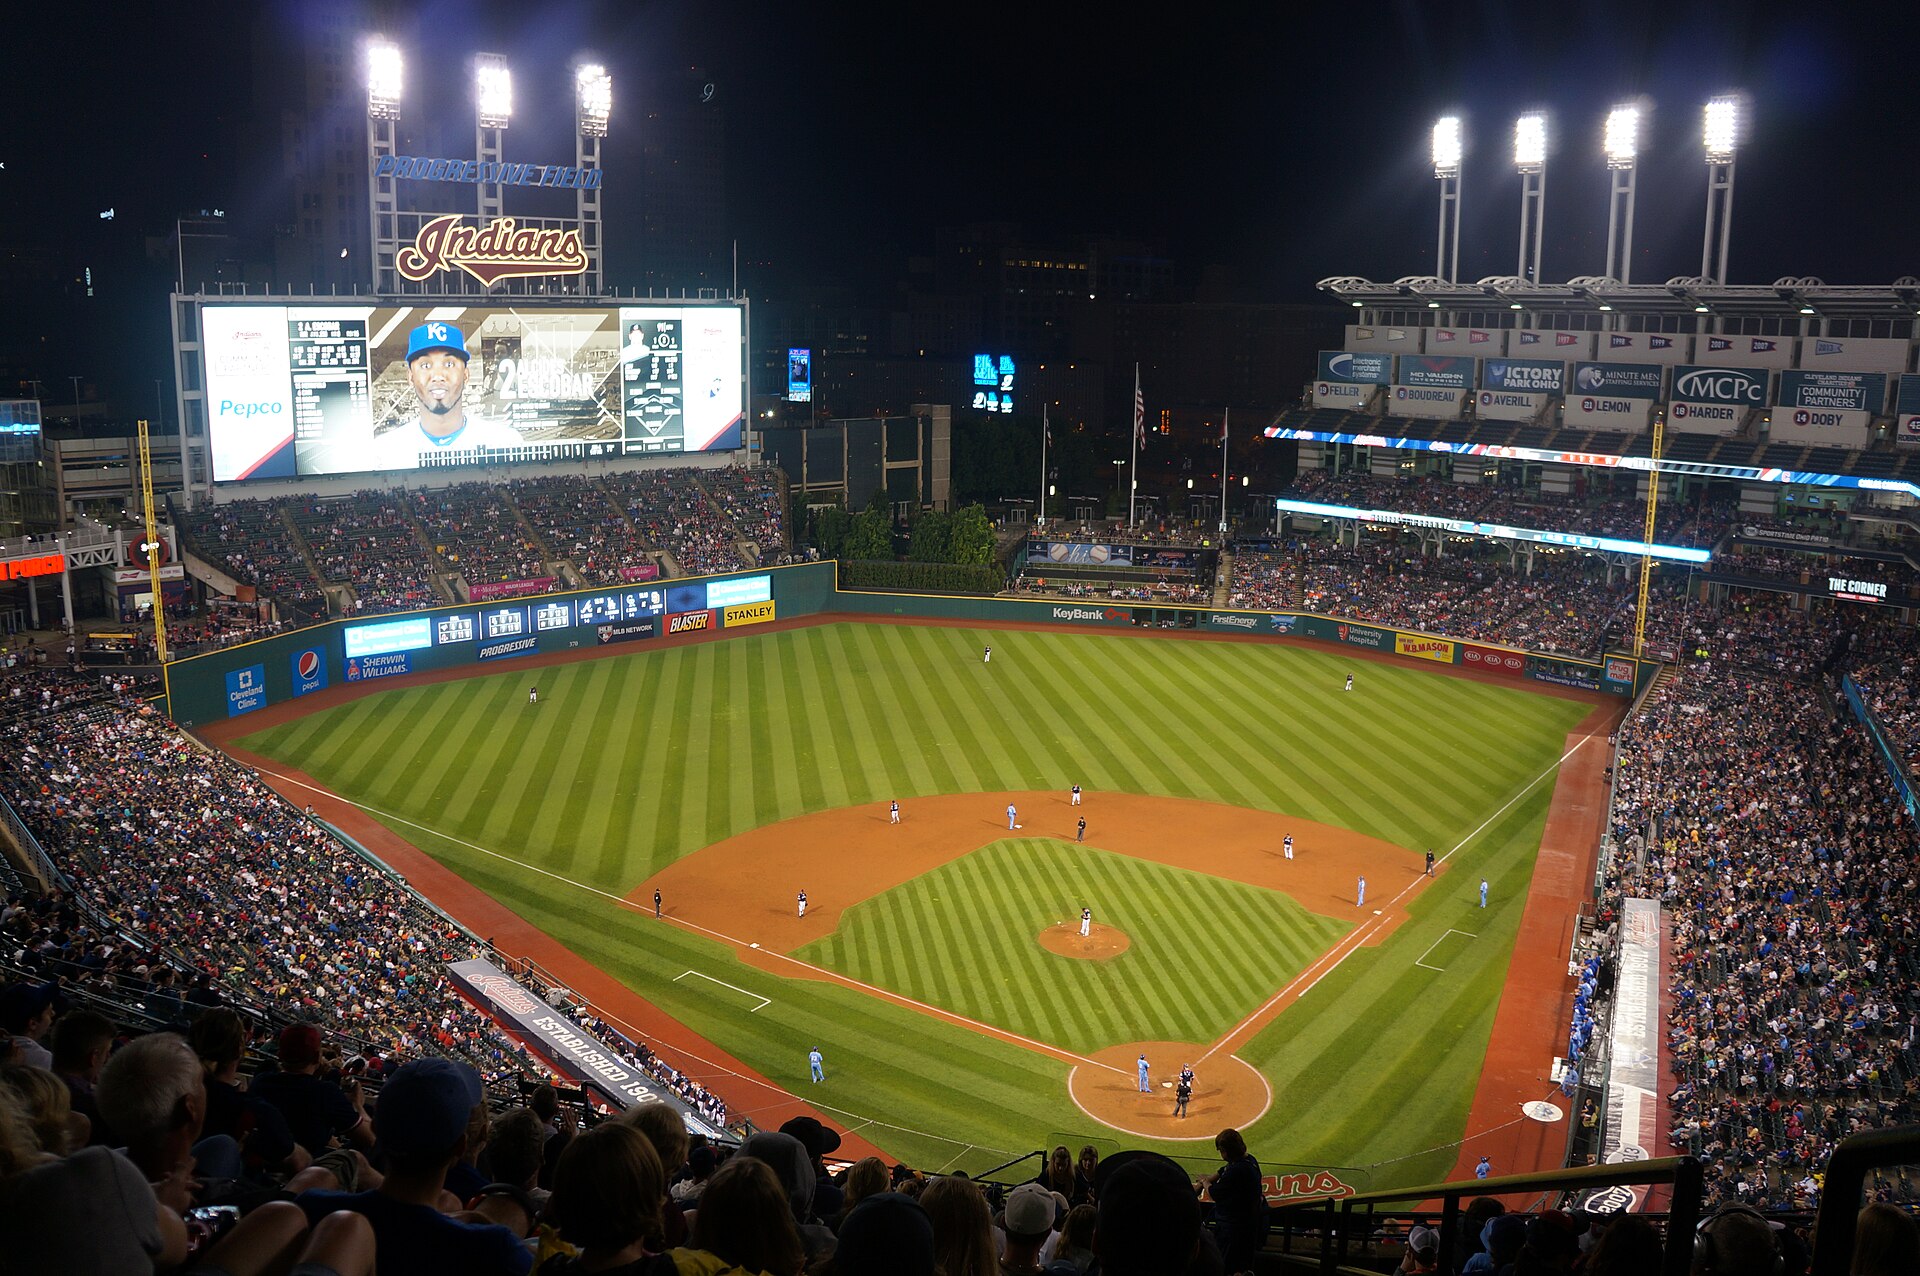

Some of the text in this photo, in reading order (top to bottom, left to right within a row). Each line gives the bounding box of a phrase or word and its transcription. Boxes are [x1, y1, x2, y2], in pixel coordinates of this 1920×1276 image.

[374, 155, 603, 189] PROGRESSIVE FIELD
[396, 213, 589, 287] Indians
[427, 323, 448, 341] KC
[1753, 342, 1769, 350] 2007
[975, 354, 992, 368] Elk
[1352, 358, 1381, 366] electronic
[499, 358, 516, 399] 2
[1426, 372, 1463, 380] VAUGHN
[1490, 365, 1562, 381] VICTORY
[1606, 371, 1659, 380] MINUTE MEN
[517, 372, 594, 399] ESCOBAR
[1504, 379, 1560, 389] PARK OHIO
[1690, 376, 1761, 401] MCPc
[1330, 386, 1359, 397] FELLER
[1408, 390, 1455, 401] BOUDREAU
[1802, 387, 1861, 398] COMMUNITY
[1483, 395, 1532, 407] 3 AVERILL
[1584, 400, 1631, 413] 21 LEMON
[1804, 396, 1855, 408] PARTNERS
[220, 400, 282, 418] Pepco
[1676, 406, 1734, 420] 18 HARDER
[1796, 413, 1843, 426] 14 DOBY
[1759, 529, 1795, 540] SPORTSTIME
[1796, 533, 1810, 541] OHIO
[1811, 535, 1829, 543] PATIO
[9, 554, 65, 579] PORCH
[1828, 577, 1846, 591] THE
[1848, 579, 1887, 597] CORNER
[727, 606, 772, 621] STANLEY
[1053, 607, 1103, 620] KeyBank
[670, 613, 708, 633] BLASTER
[1212, 615, 1256, 627] FirstEnergy
[626, 624, 653, 634] NETWORK
[1349, 626, 1382, 638] University
[1348, 634, 1379, 646] Hospitals
[480, 638, 537, 658] PROGRESSIVE
[363, 654, 405, 668] SHERWIN
[1609, 663, 1629, 675] drug
[1546, 675, 1570, 686] University
[1577, 681, 1595, 690] Toledo
[1609, 672, 1632, 682] mart
[302, 679, 319, 692] pepsi
[230, 684, 263, 702] Cleveland
[237, 697, 257, 709] Clinic
[467, 974, 538, 1015] Indians
[532, 1016, 630, 1089] ESTABLISHED
[1597, 1186, 1631, 1217] 2007
